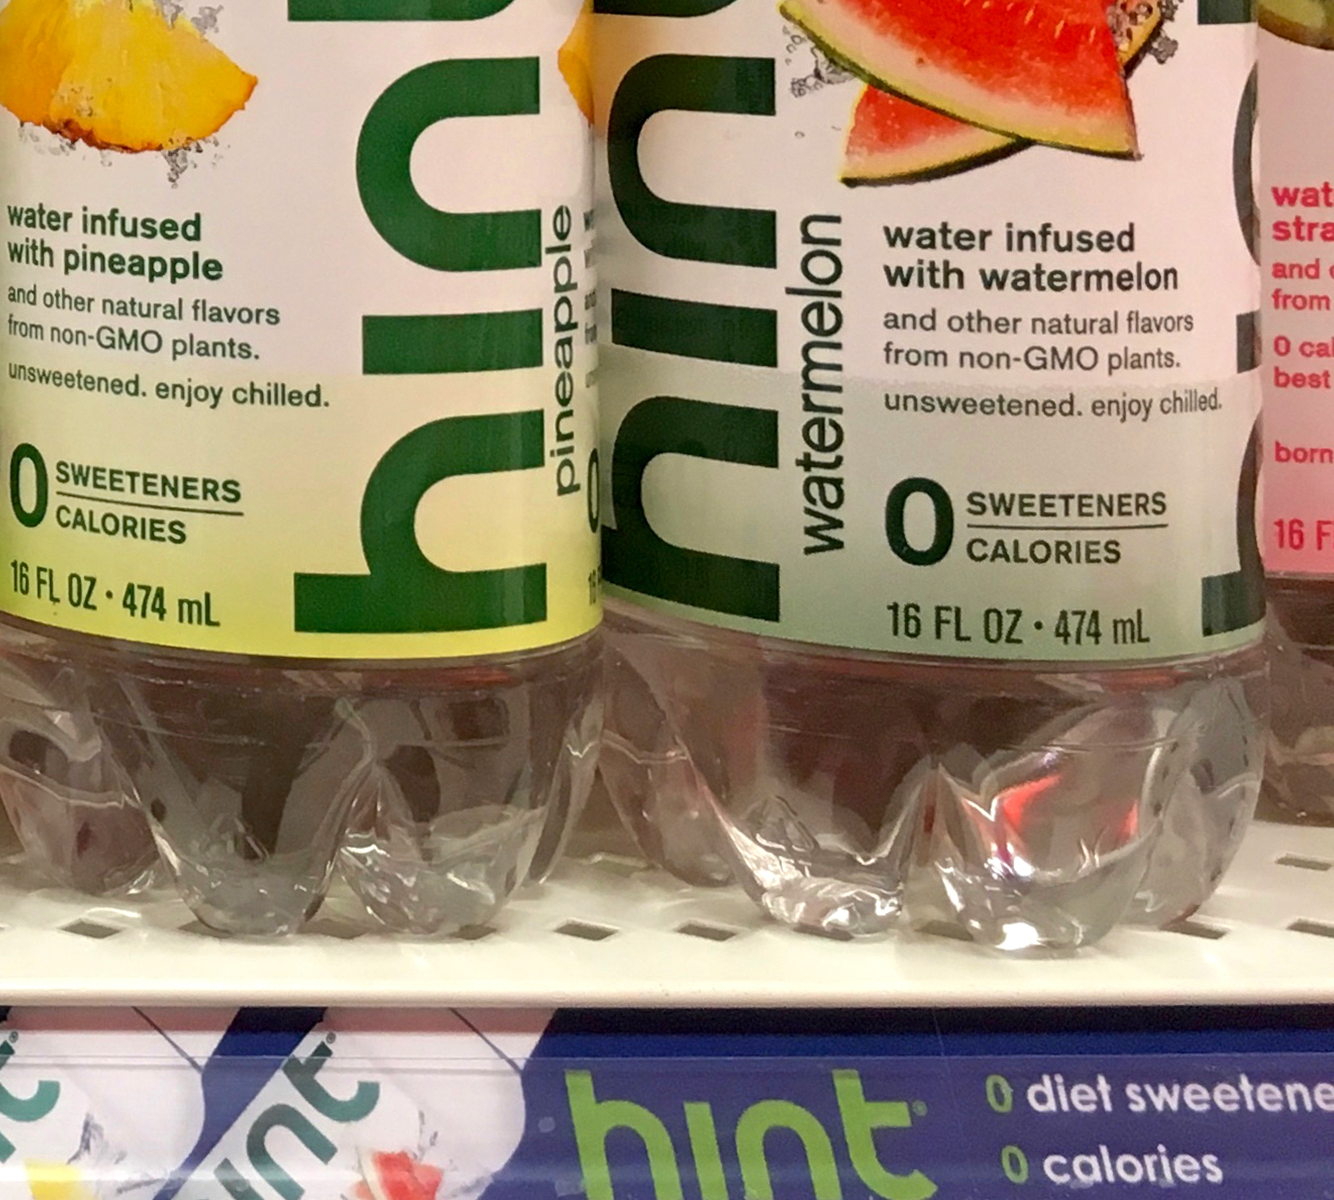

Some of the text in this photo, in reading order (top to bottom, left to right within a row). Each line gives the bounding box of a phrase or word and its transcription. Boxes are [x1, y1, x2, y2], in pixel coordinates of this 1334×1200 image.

[7, 203, 201, 241] water infused
[884, 222, 1134, 252] water infused
[8, 238, 222, 284] with pineapple
[884, 259, 1177, 292] with watermelon
[1272, 258, 1320, 279] and
[8, 284, 280, 325] and other natural flavors
[1271, 288, 1330, 310] from
[8, 313, 259, 361] from non-GMO plants.
[884, 308, 1193, 335] and other natural flavors
[545, 206, 580, 496] pineapple
[884, 342, 1180, 376] from non-GMO plants.
[9, 363, 329, 409] unsweetened. enjoy chilled.
[786, 215, 844, 556] watermelon
[1274, 366, 1330, 389] best
[885, 387, 1222, 423] unsweetened. enjoy chilled.
[10, 443, 48, 527] 0
[55, 460, 241, 503] SWEETENERS
[886, 478, 954, 566] 0
[967, 492, 1166, 517] SWEETENERS
[56, 505, 186, 544] CALORIES
[1274, 519, 1304, 550] 16
[967, 538, 1120, 564] CALORIES
[123, 583, 220, 626] 474 mL
[887, 602, 1102, 645] 16 FL OZ 474
[986, 1075, 1013, 1112] 0
[1027, 1074, 1112, 1112] diet
[565, 1068, 937, 1200] hint
[1043, 1144, 1223, 1185] calories
